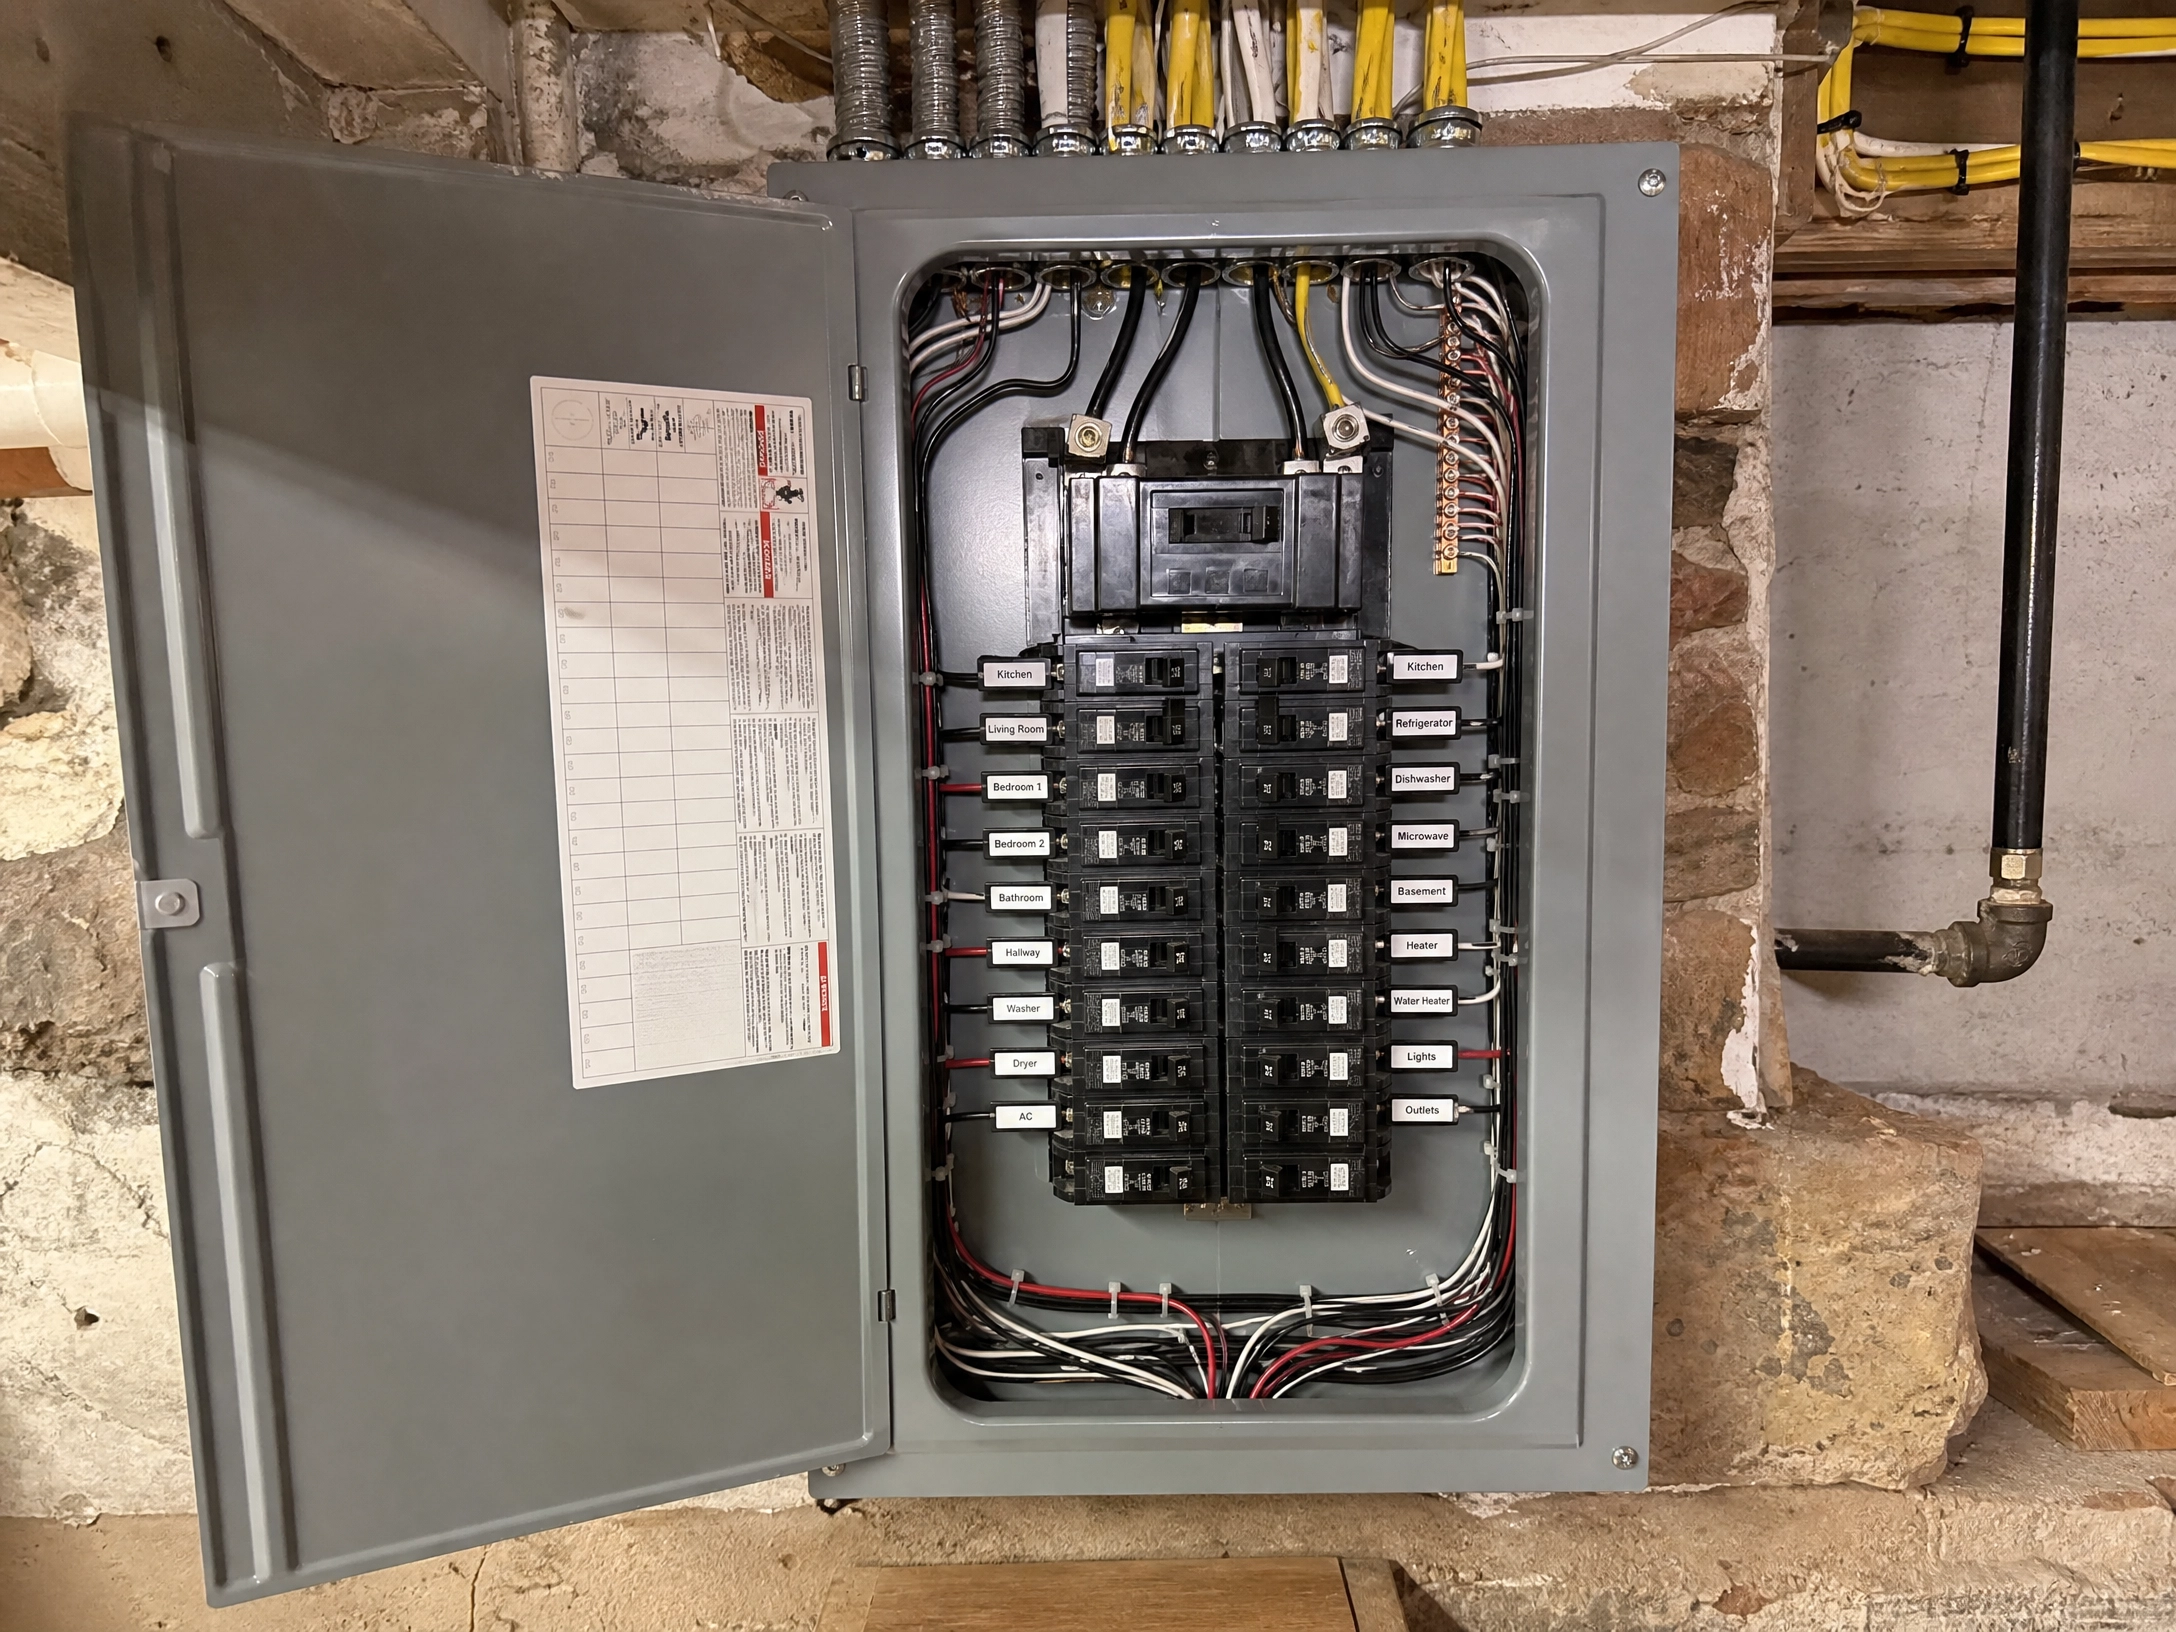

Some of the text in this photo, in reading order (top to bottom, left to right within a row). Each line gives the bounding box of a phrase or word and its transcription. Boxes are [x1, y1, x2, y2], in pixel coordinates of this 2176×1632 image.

[1407, 661, 1444, 672] Kitchen
[997, 669, 1033, 679] Kitchen
[1395, 718, 1453, 730] Refrigerator
[988, 724, 1045, 736] Living Room
[1395, 773, 1451, 784] Dishwasher
[993, 782, 1042, 792] Bedroom 1
[1397, 831, 1449, 841] Microwave
[994, 838, 1045, 849] Bedroom 2
[1397, 886, 1447, 896] Basement
[998, 893, 1044, 903] Bathroom
[1406, 940, 1439, 950] Heater
[1005, 948, 1041, 959] Hallway
[1393, 996, 1451, 1006] Water Heater
[1006, 1004, 1041, 1014] Washer
[1406, 1051, 1437, 1063] Lights
[1012, 1058, 1037, 1070] Dryer
[1405, 1105, 1440, 1115] Outlets
[1018, 1111, 1033, 1121] AC
